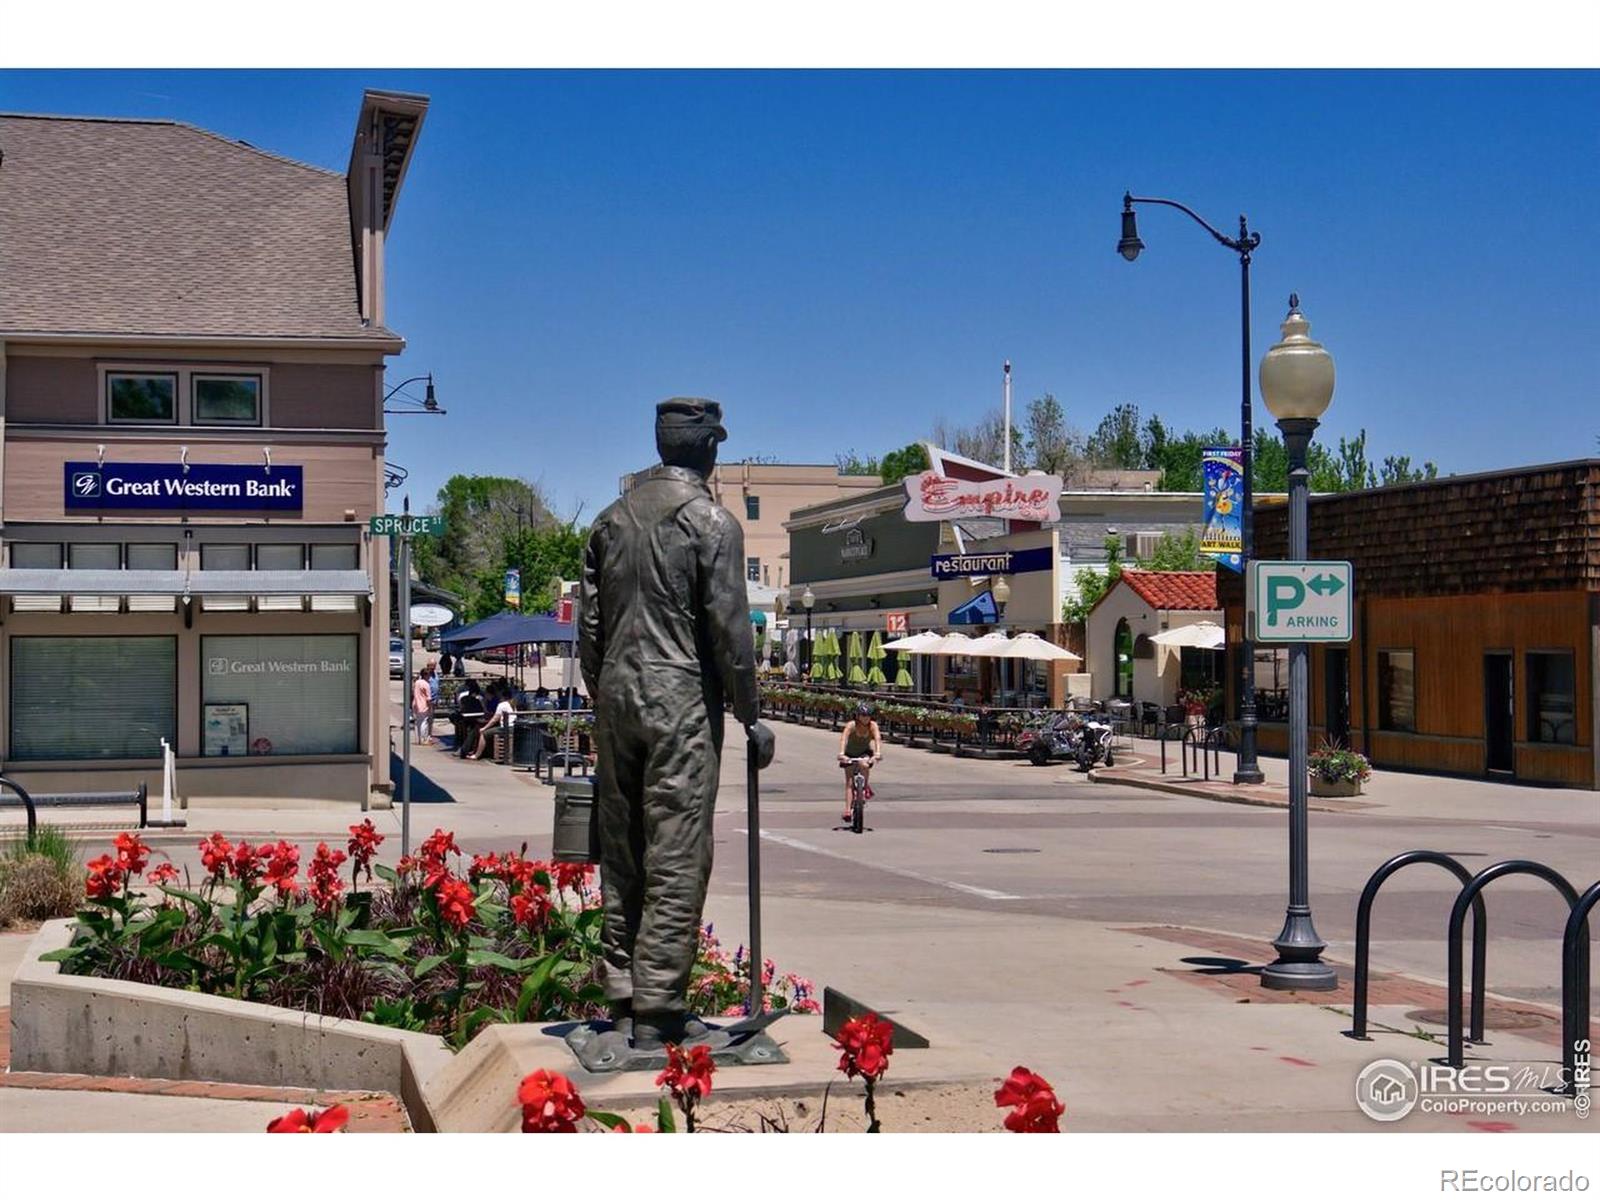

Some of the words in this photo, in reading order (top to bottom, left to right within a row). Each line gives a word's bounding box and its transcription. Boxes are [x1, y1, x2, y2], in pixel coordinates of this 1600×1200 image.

[106, 478, 161, 496] Great
[164, 478, 240, 496] Western
[920, 475, 1050, 515] Empire
[375, 518, 430, 533] SPRUCE
[1201, 541, 1216, 549] ART
[1218, 541, 1241, 549] WALK
[935, 551, 1014, 574] restaurant
[889, 615, 906, 632] 12
[231, 661, 266, 674] Great
[268, 660, 318, 673] Western
[320, 658, 351, 673] Bank
